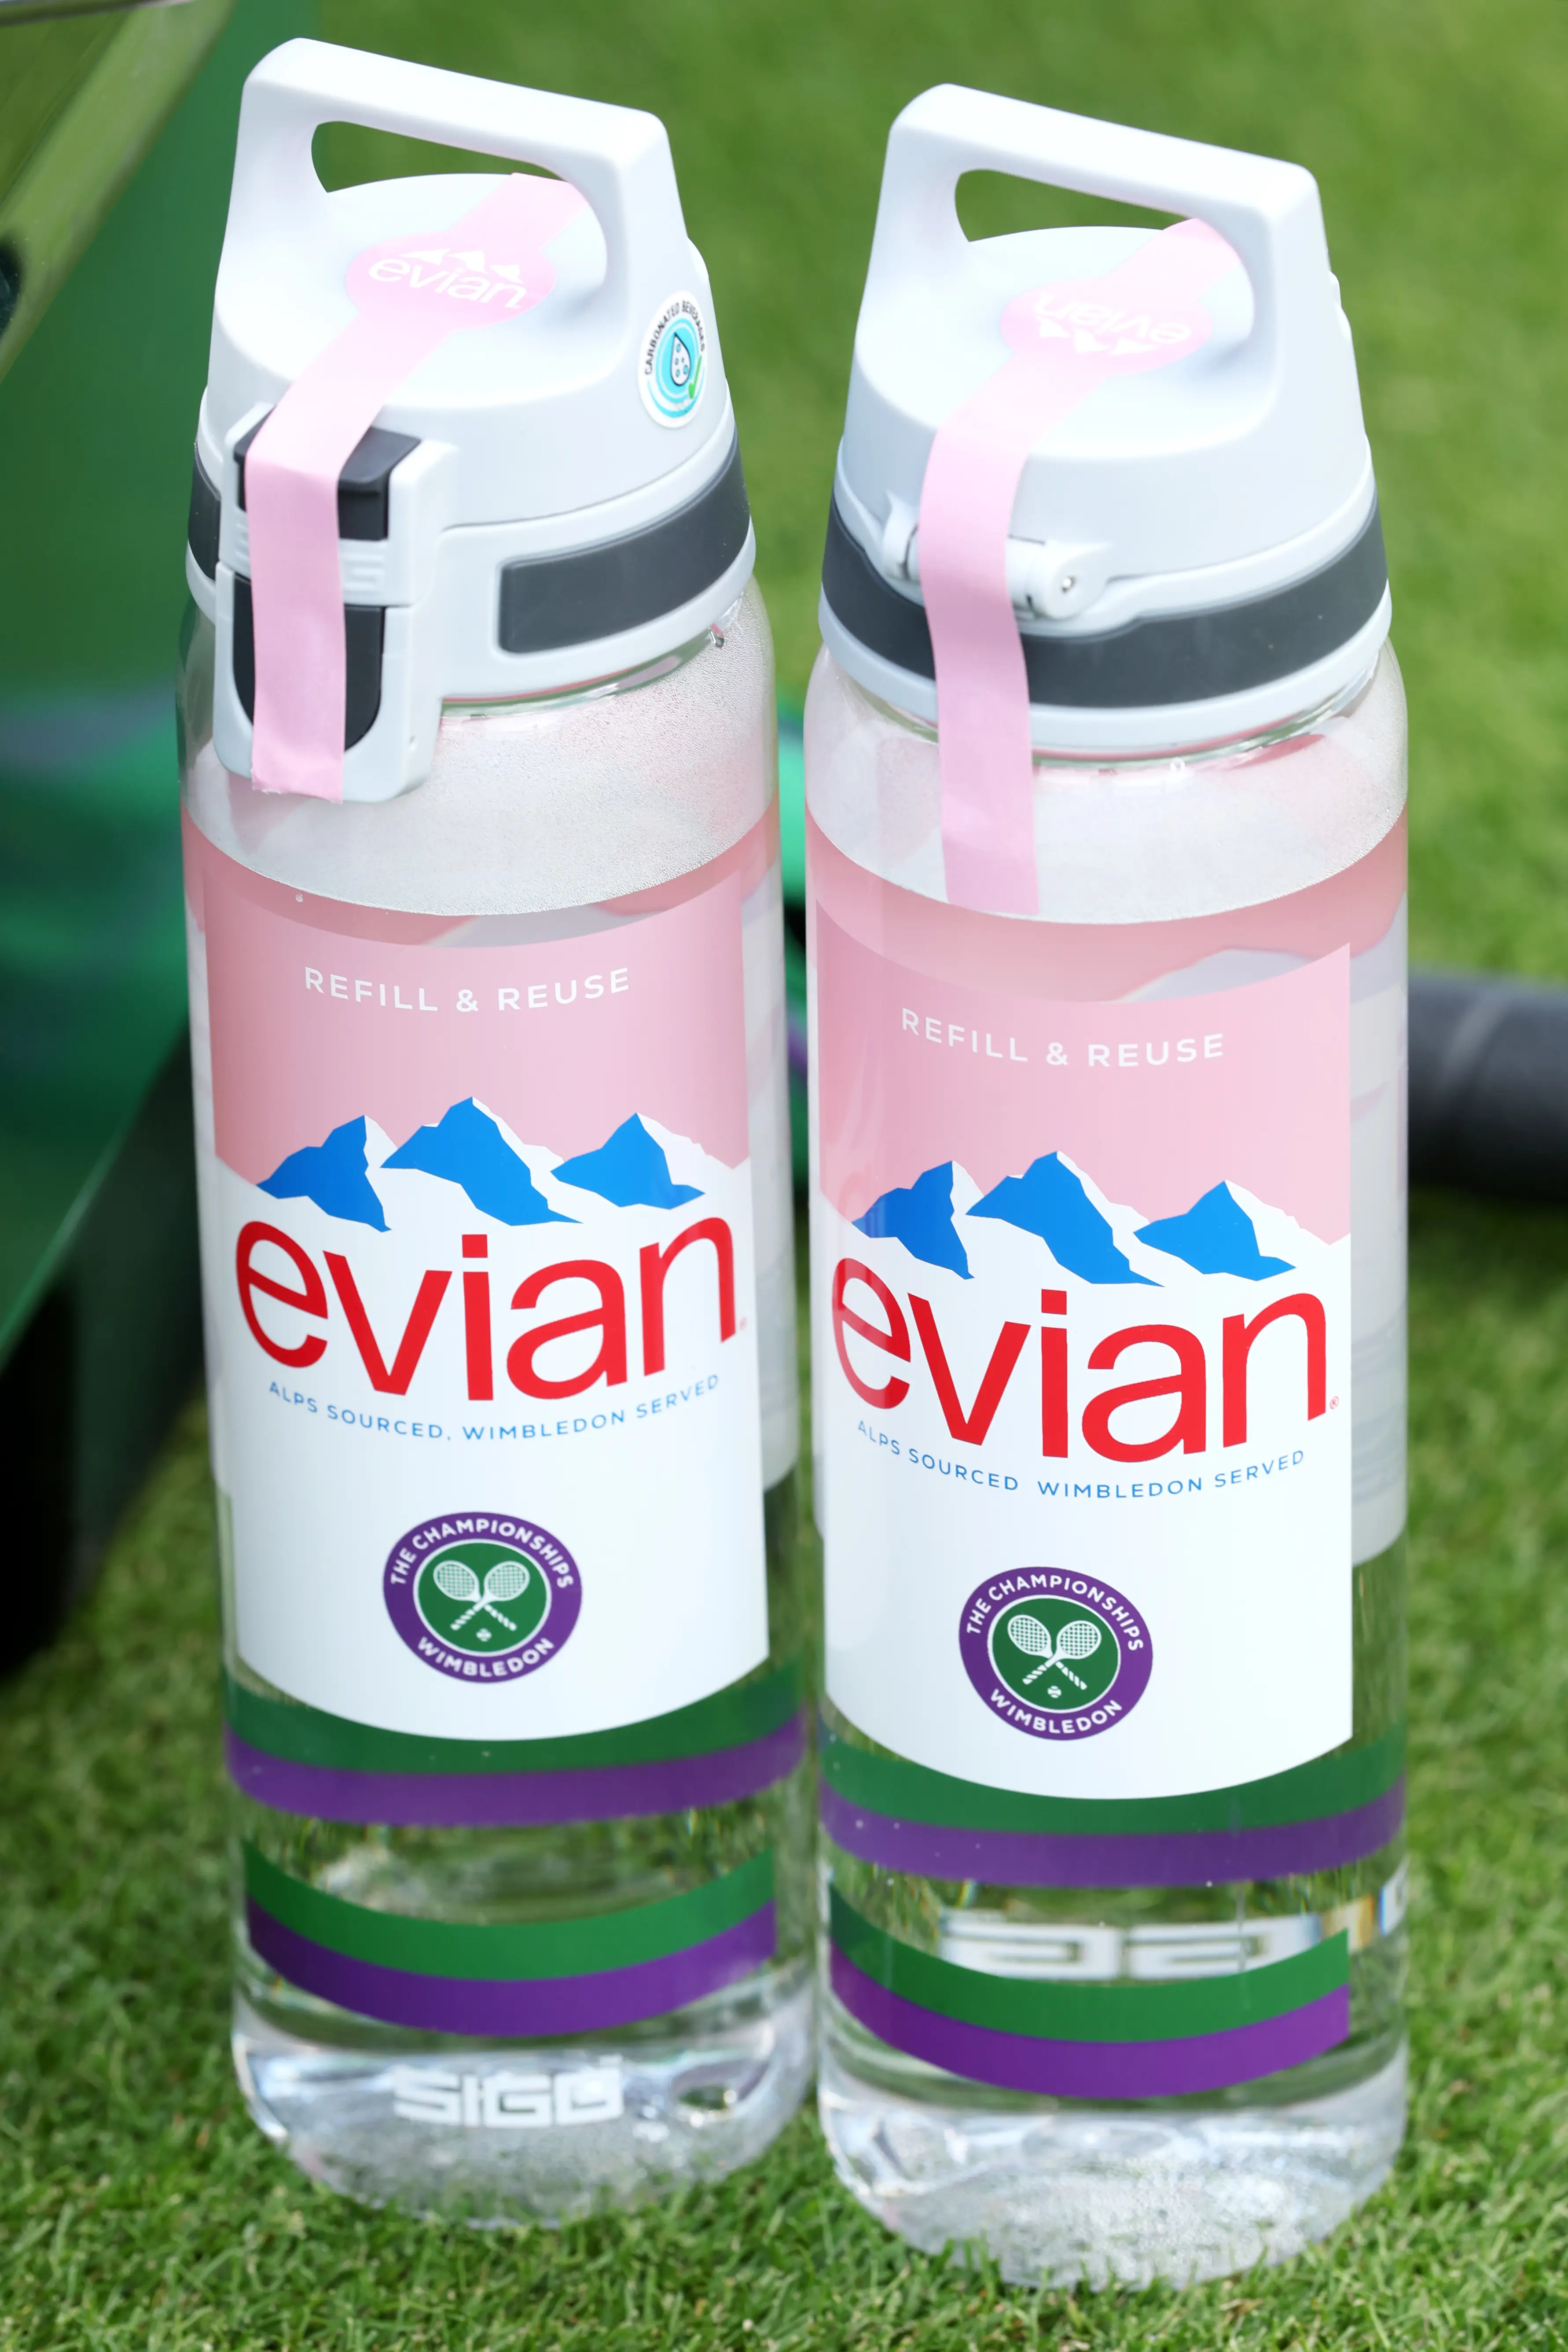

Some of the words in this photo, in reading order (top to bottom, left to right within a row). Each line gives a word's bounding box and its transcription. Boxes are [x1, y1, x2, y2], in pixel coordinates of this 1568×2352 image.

[368, 259, 527, 309] evian
[1032, 291, 1192, 344] evian
[644, 302, 680, 375] CARBONATED
[305, 967, 438, 1012] REFILL
[455, 989, 479, 1012] &
[498, 967, 629, 1011] REUSE
[902, 1007, 1028, 1062] REFILL
[1046, 1042, 1068, 1066] &
[1088, 1033, 1223, 1067] REUSE
[235, 1217, 737, 1401] evian
[832, 1257, 1327, 1463] evian
[268, 1381, 318, 1413] ALPS
[327, 1405, 452, 1441] SOURCED,
[462, 1409, 625, 1440] WIMBLEDON
[636, 1374, 719, 1419] SERVED
[857, 1420, 900, 1455] ALPS
[908, 1448, 1019, 1491] SOURCED
[1037, 1477, 1202, 1499] WIMBLEDON
[1214, 1450, 1304, 1488] SERVED
[390, 1547, 417, 1584] THE
[412, 1518, 574, 1588] CHAMPIONSHIPS
[966, 1598, 991, 1634] THE
[988, 1574, 1144, 1650] CHAMPIONSHIPS
[418, 1636, 554, 1677] WIMBLEDON
[990, 1688, 1123, 1734] WIMBLEDON
